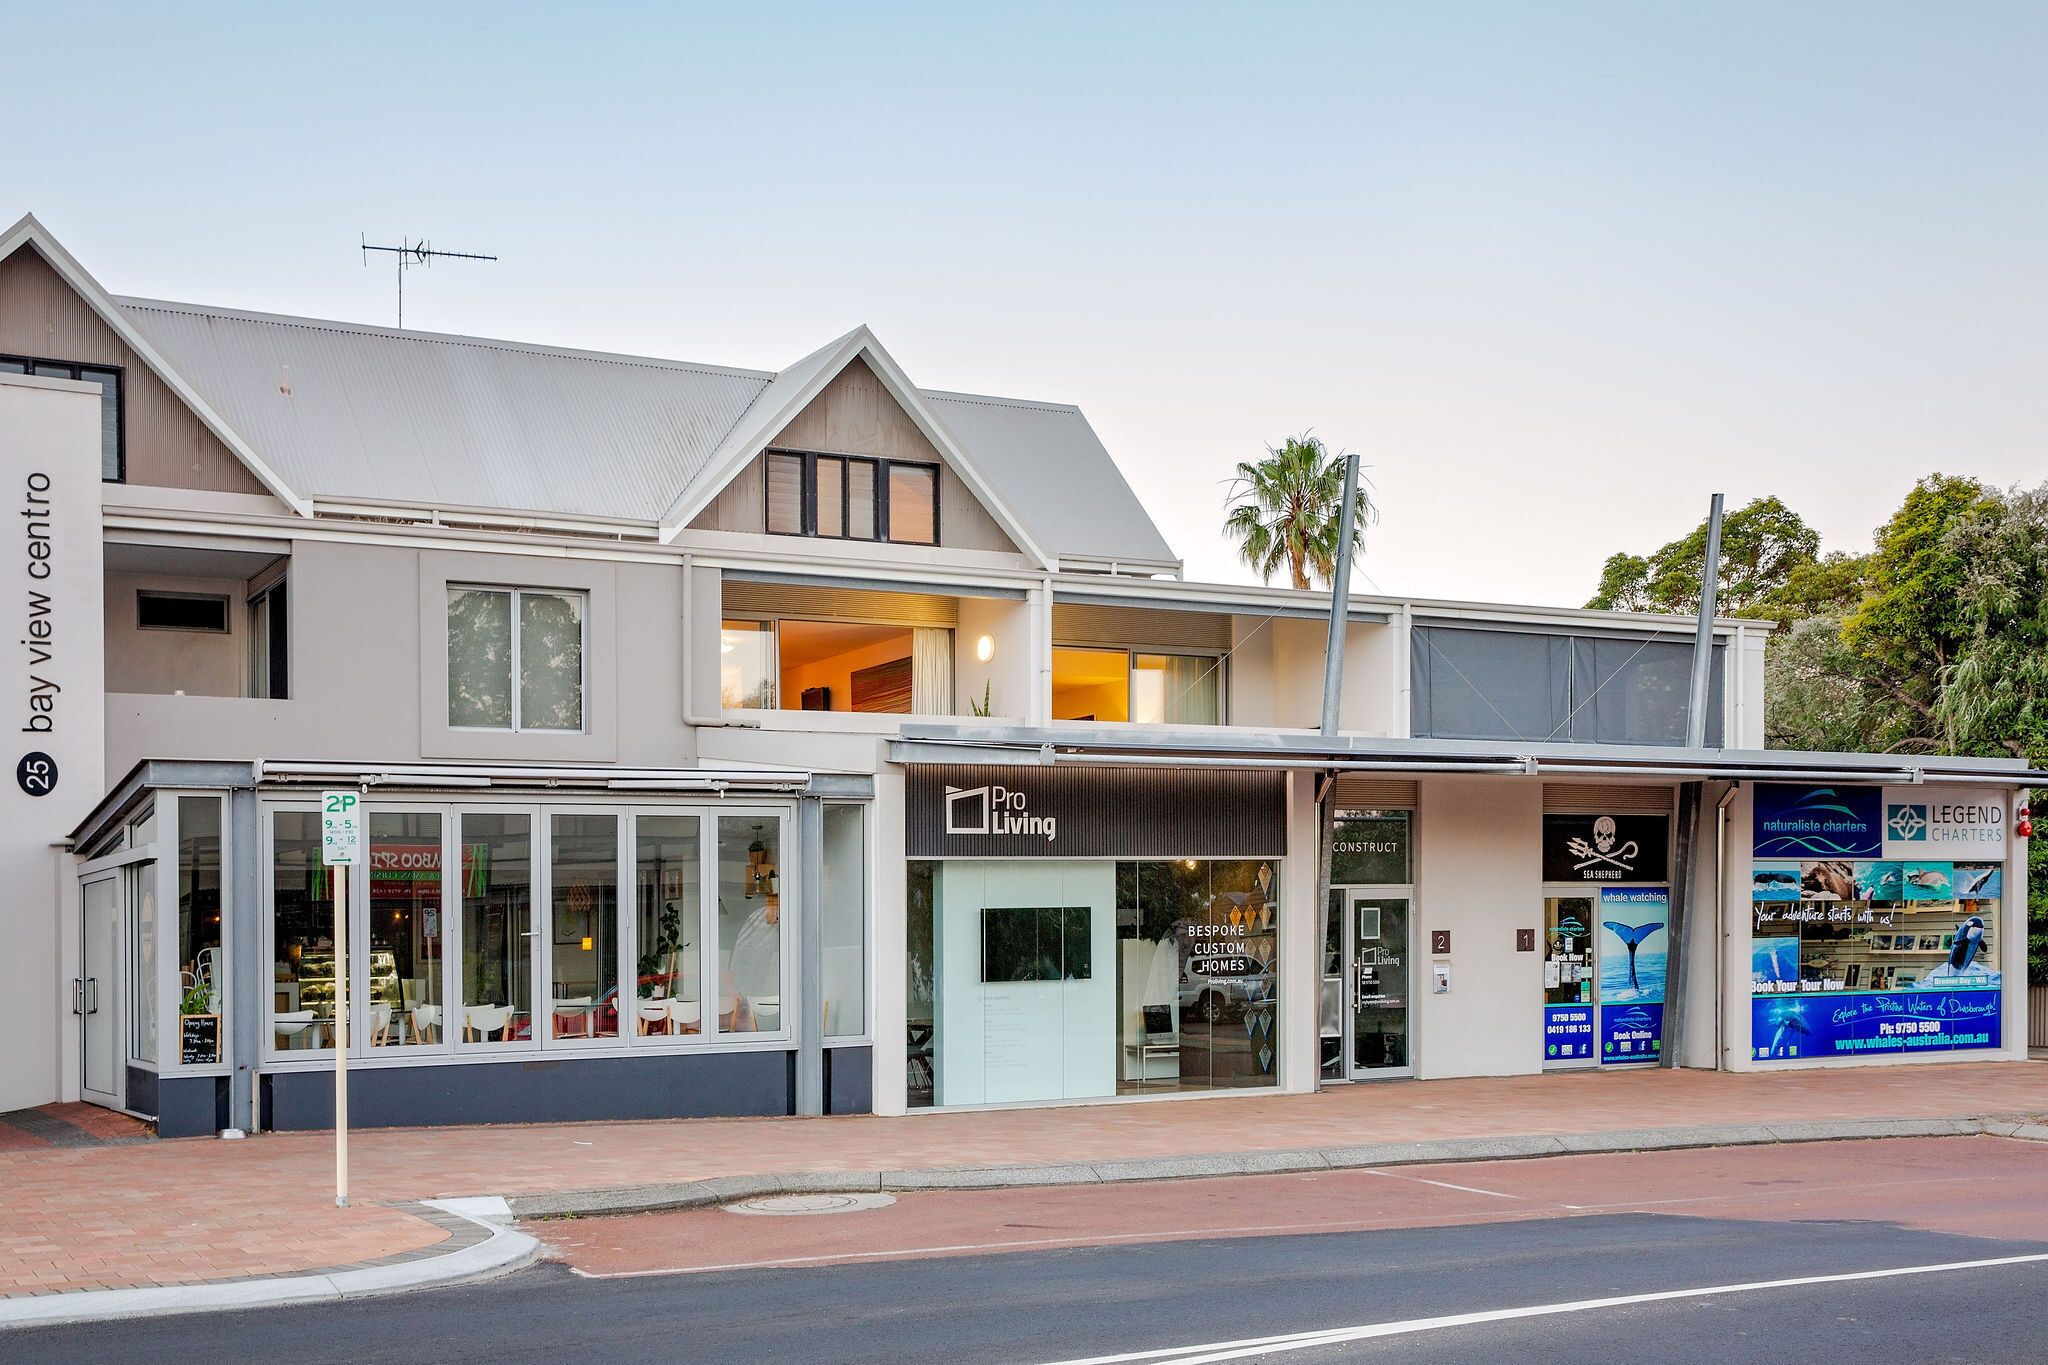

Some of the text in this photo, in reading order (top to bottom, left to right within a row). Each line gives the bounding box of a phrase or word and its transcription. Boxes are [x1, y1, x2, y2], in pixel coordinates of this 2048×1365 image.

[20, 472, 61, 790] 25 bay view centro
[326, 795, 356, 812] 2P
[992, 786, 1026, 810] Pro
[1932, 805, 2002, 824] LEGEND
[992, 811, 1056, 842] Living
[1763, 818, 1867, 833] naturaliste charters
[1932, 827, 2002, 842] CHARTERS
[1332, 842, 1398, 852] CONSTRUCT
[1583, 870, 1622, 879] SEA SHEPHERD
[1603, 892, 1667, 904] whale watching
[1754, 901, 1896, 930] Your adventure starts with us!
[1188, 925, 1244, 936] BESPOKE
[1438, 935, 1445, 948] 2
[1523, 934, 1528, 947] 1
[1194, 942, 1244, 954] CUSTOM
[1378, 946, 1390, 956] Pro
[1378, 956, 1400, 966] Living
[1569, 953, 1584, 961] Now
[1202, 960, 1244, 972] HOMES
[1752, 979, 1845, 992] Book Your Tour Now
[1832, 1007, 1858, 1023] Explore
[1861, 1002, 1873, 1013] the
[1876, 996, 1904, 1013] Pristine
[1908, 995, 1933, 1014] Waters
[1937, 996, 1947, 1016] of
[1552, 1013, 1586, 1022] 9750 5500
[1547, 1026, 1564, 1034] 0419
[1880, 1021, 1940, 1035] Ph: 9750 5500
[1614, 1031, 1652, 1040] Book Online
[1835, 1032, 1989, 1050] www.whales-australia.com.au
